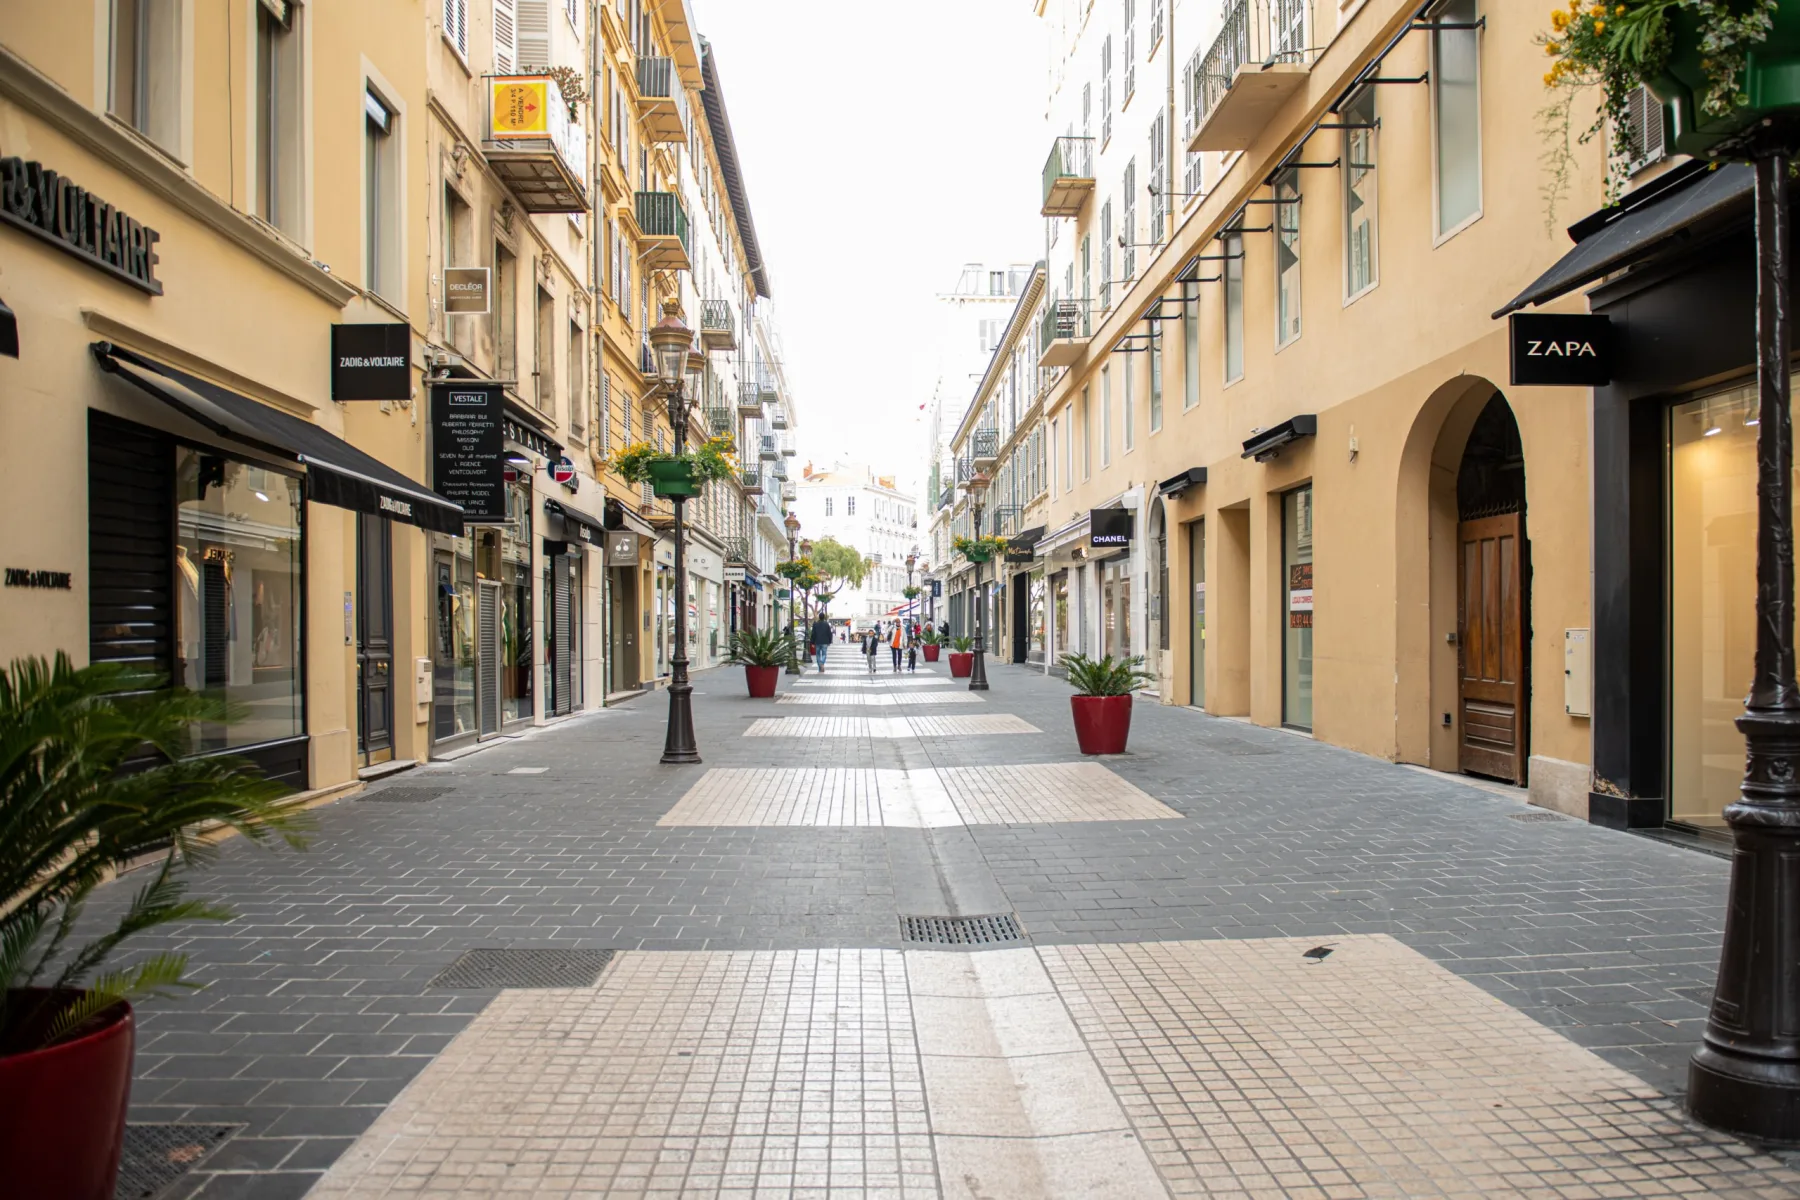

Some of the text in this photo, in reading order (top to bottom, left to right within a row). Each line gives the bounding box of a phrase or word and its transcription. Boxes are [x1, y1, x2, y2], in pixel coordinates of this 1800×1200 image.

[449, 282, 483, 290] DECLÉOR
[1527, 340, 1597, 357] ZAPA
[1092, 535, 1127, 543] CHANEL
